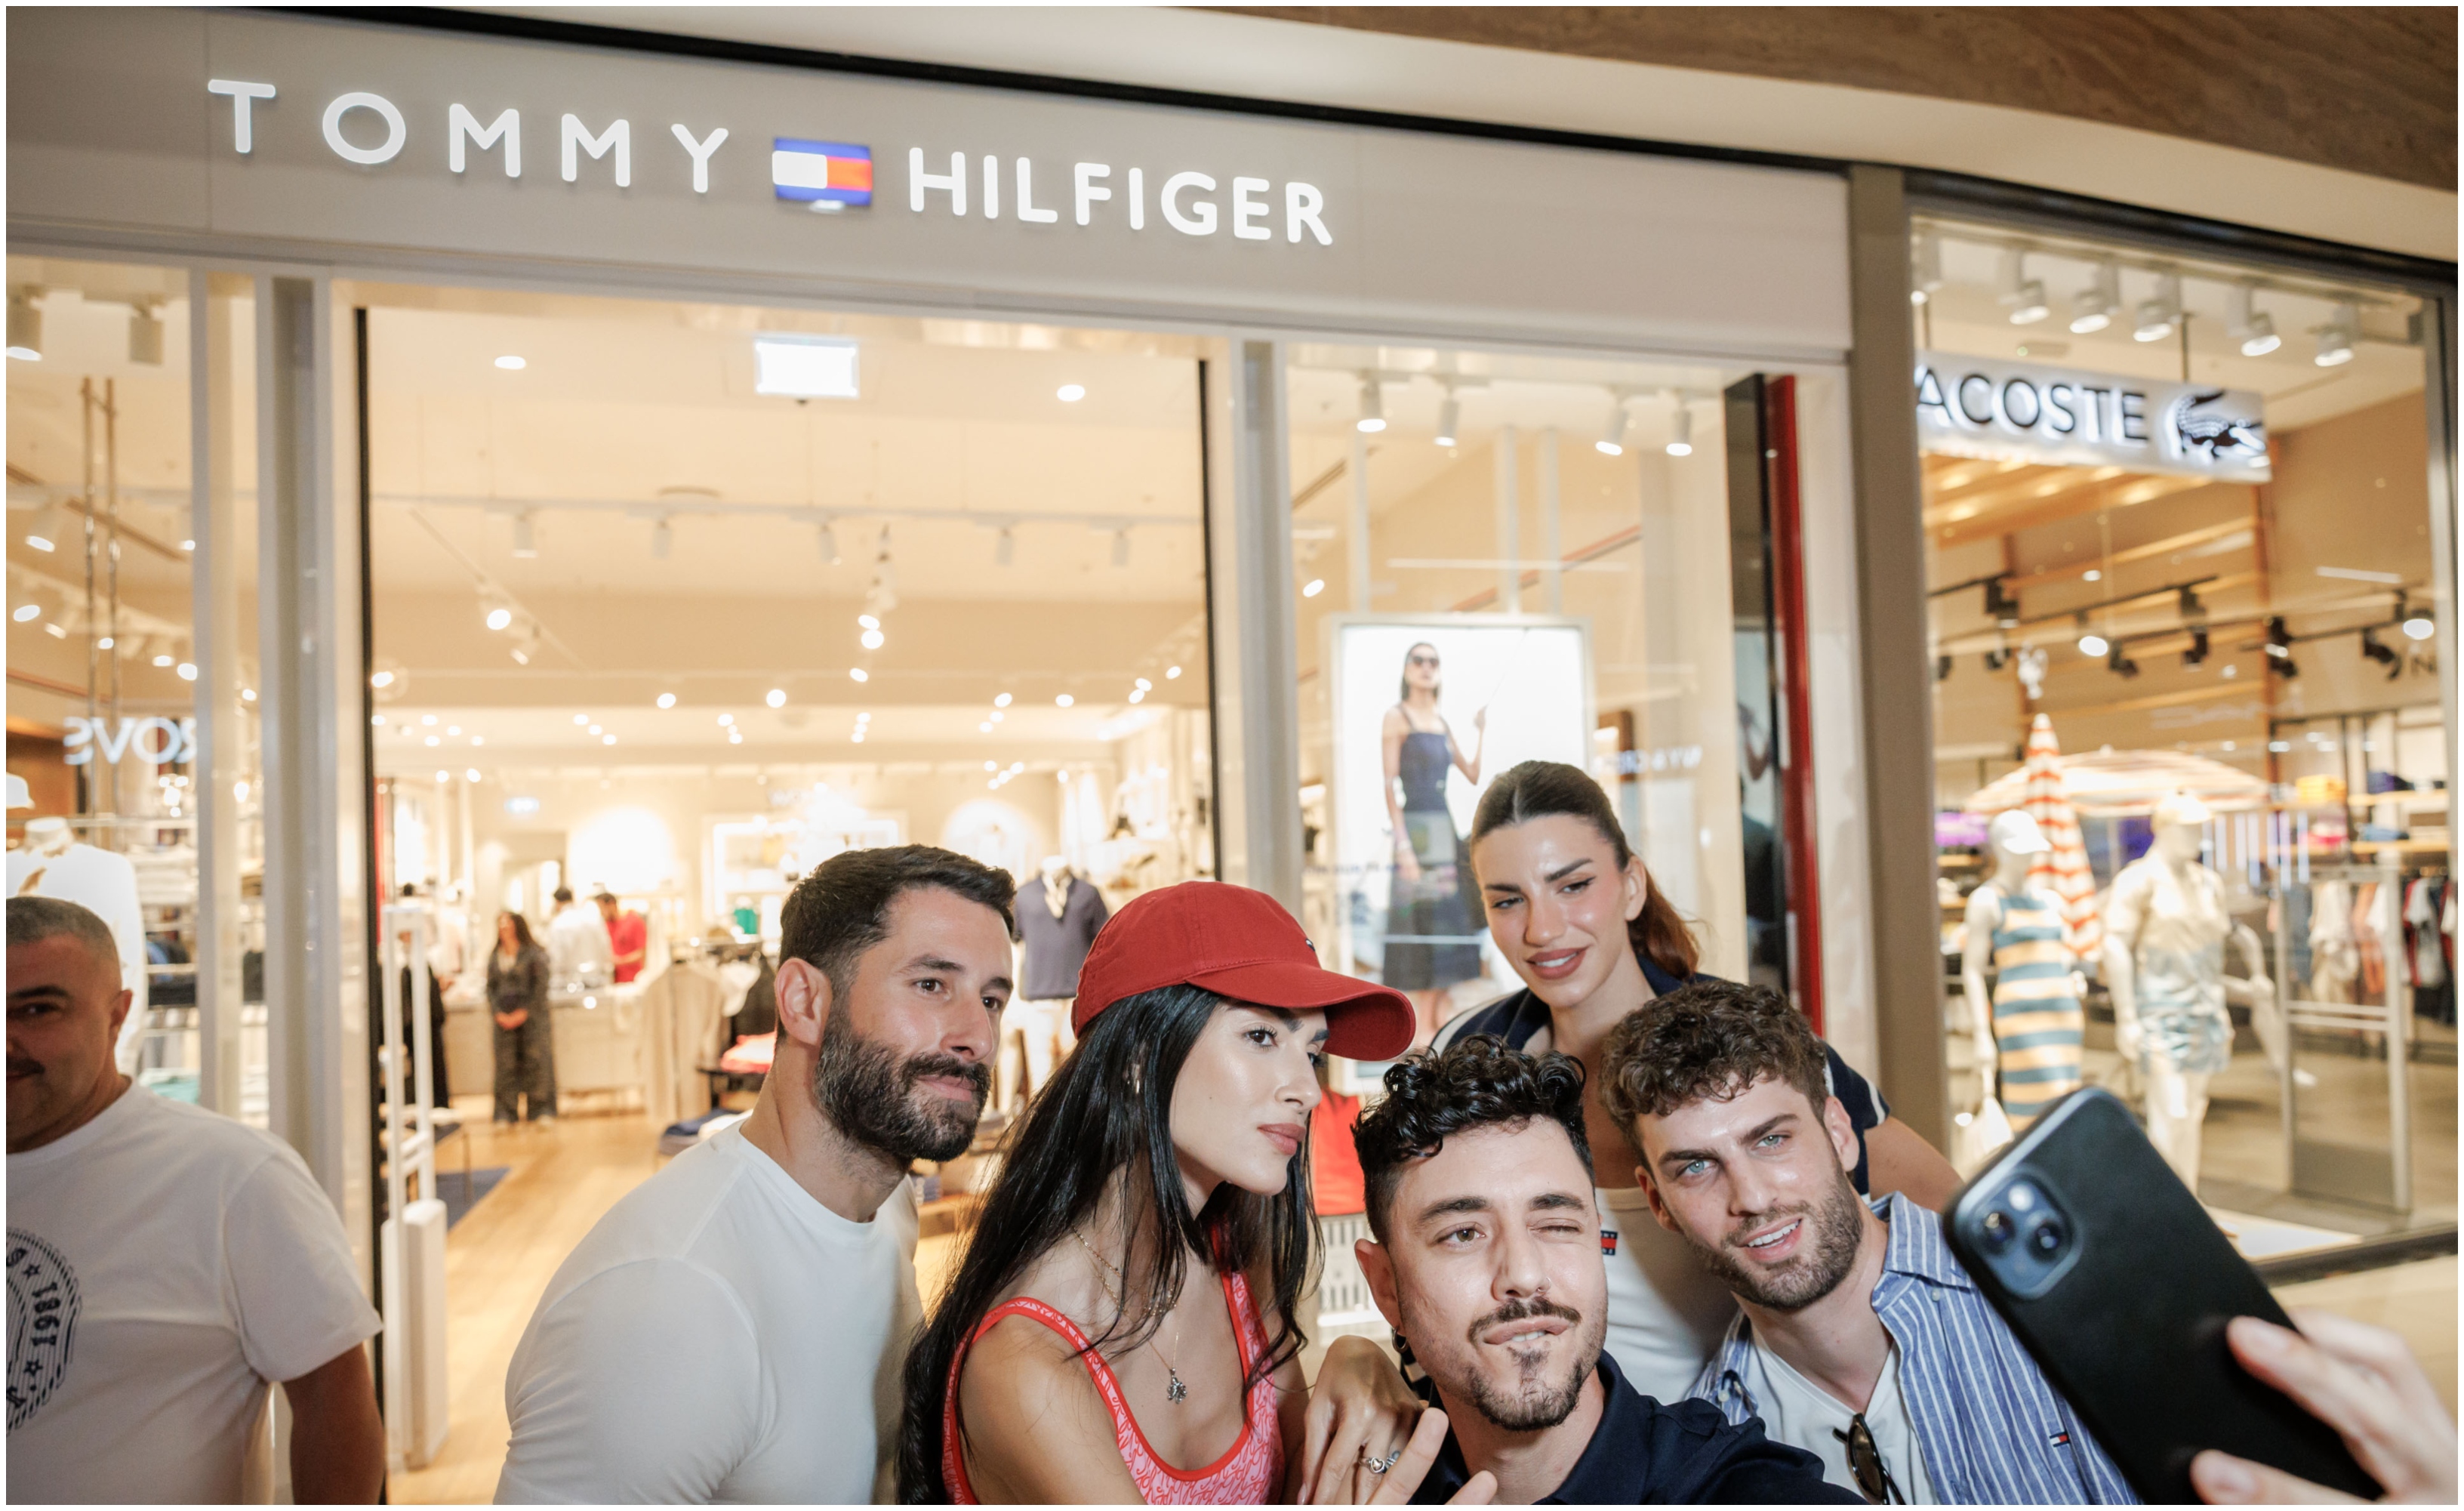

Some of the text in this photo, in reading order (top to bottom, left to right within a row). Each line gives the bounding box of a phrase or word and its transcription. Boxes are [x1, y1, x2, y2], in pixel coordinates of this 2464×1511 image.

[208, 79, 1334, 245] TOMMY HILFIGER
[1917, 367, 2150, 440] ACOSTE
